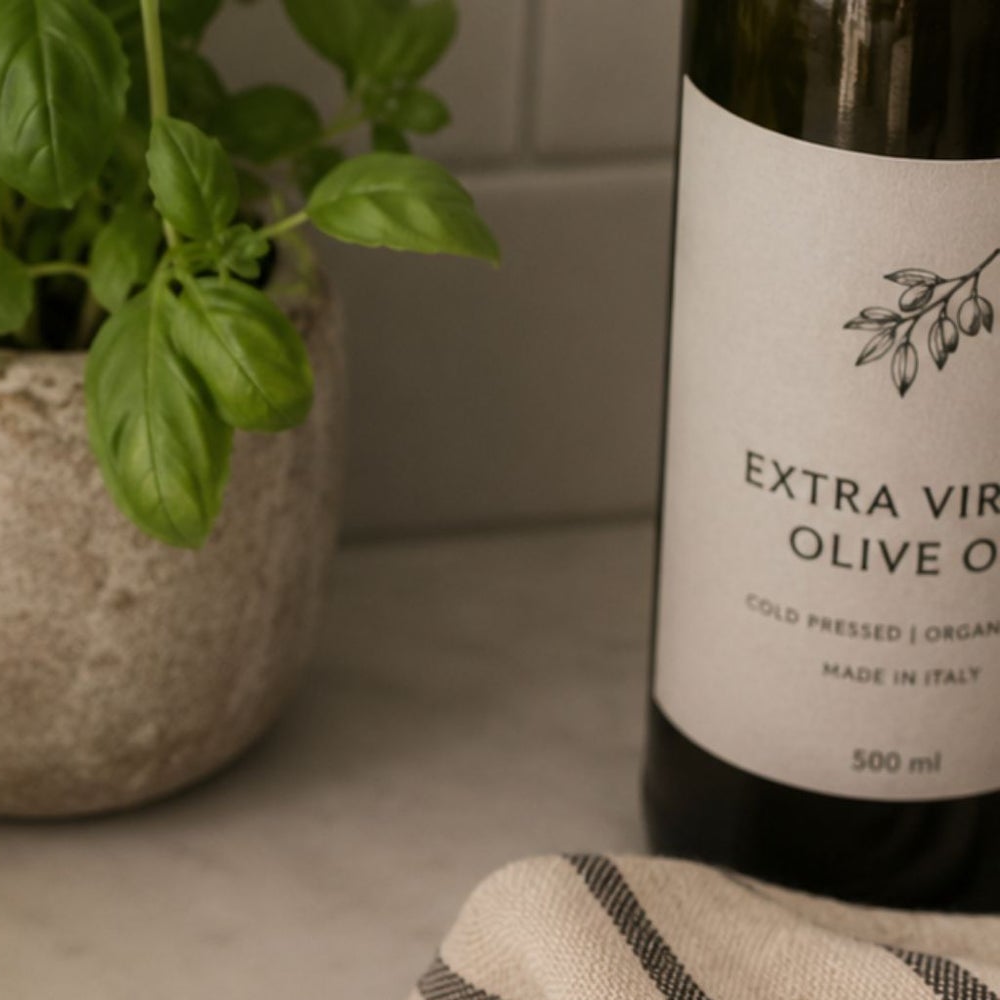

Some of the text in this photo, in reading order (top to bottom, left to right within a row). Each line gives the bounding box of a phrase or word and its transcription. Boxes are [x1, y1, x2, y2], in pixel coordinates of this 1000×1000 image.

[744, 450, 1000, 520] EXTRA VIR
[789, 525, 998, 576] OLIVE O
[745, 593, 800, 625] COLD
[807, 614, 902, 643] PRESSED
[924, 620, 1000, 644] ORGAN
[822, 661, 983, 687] MADE IN ITALY
[851, 749, 943, 775] 500 ml
